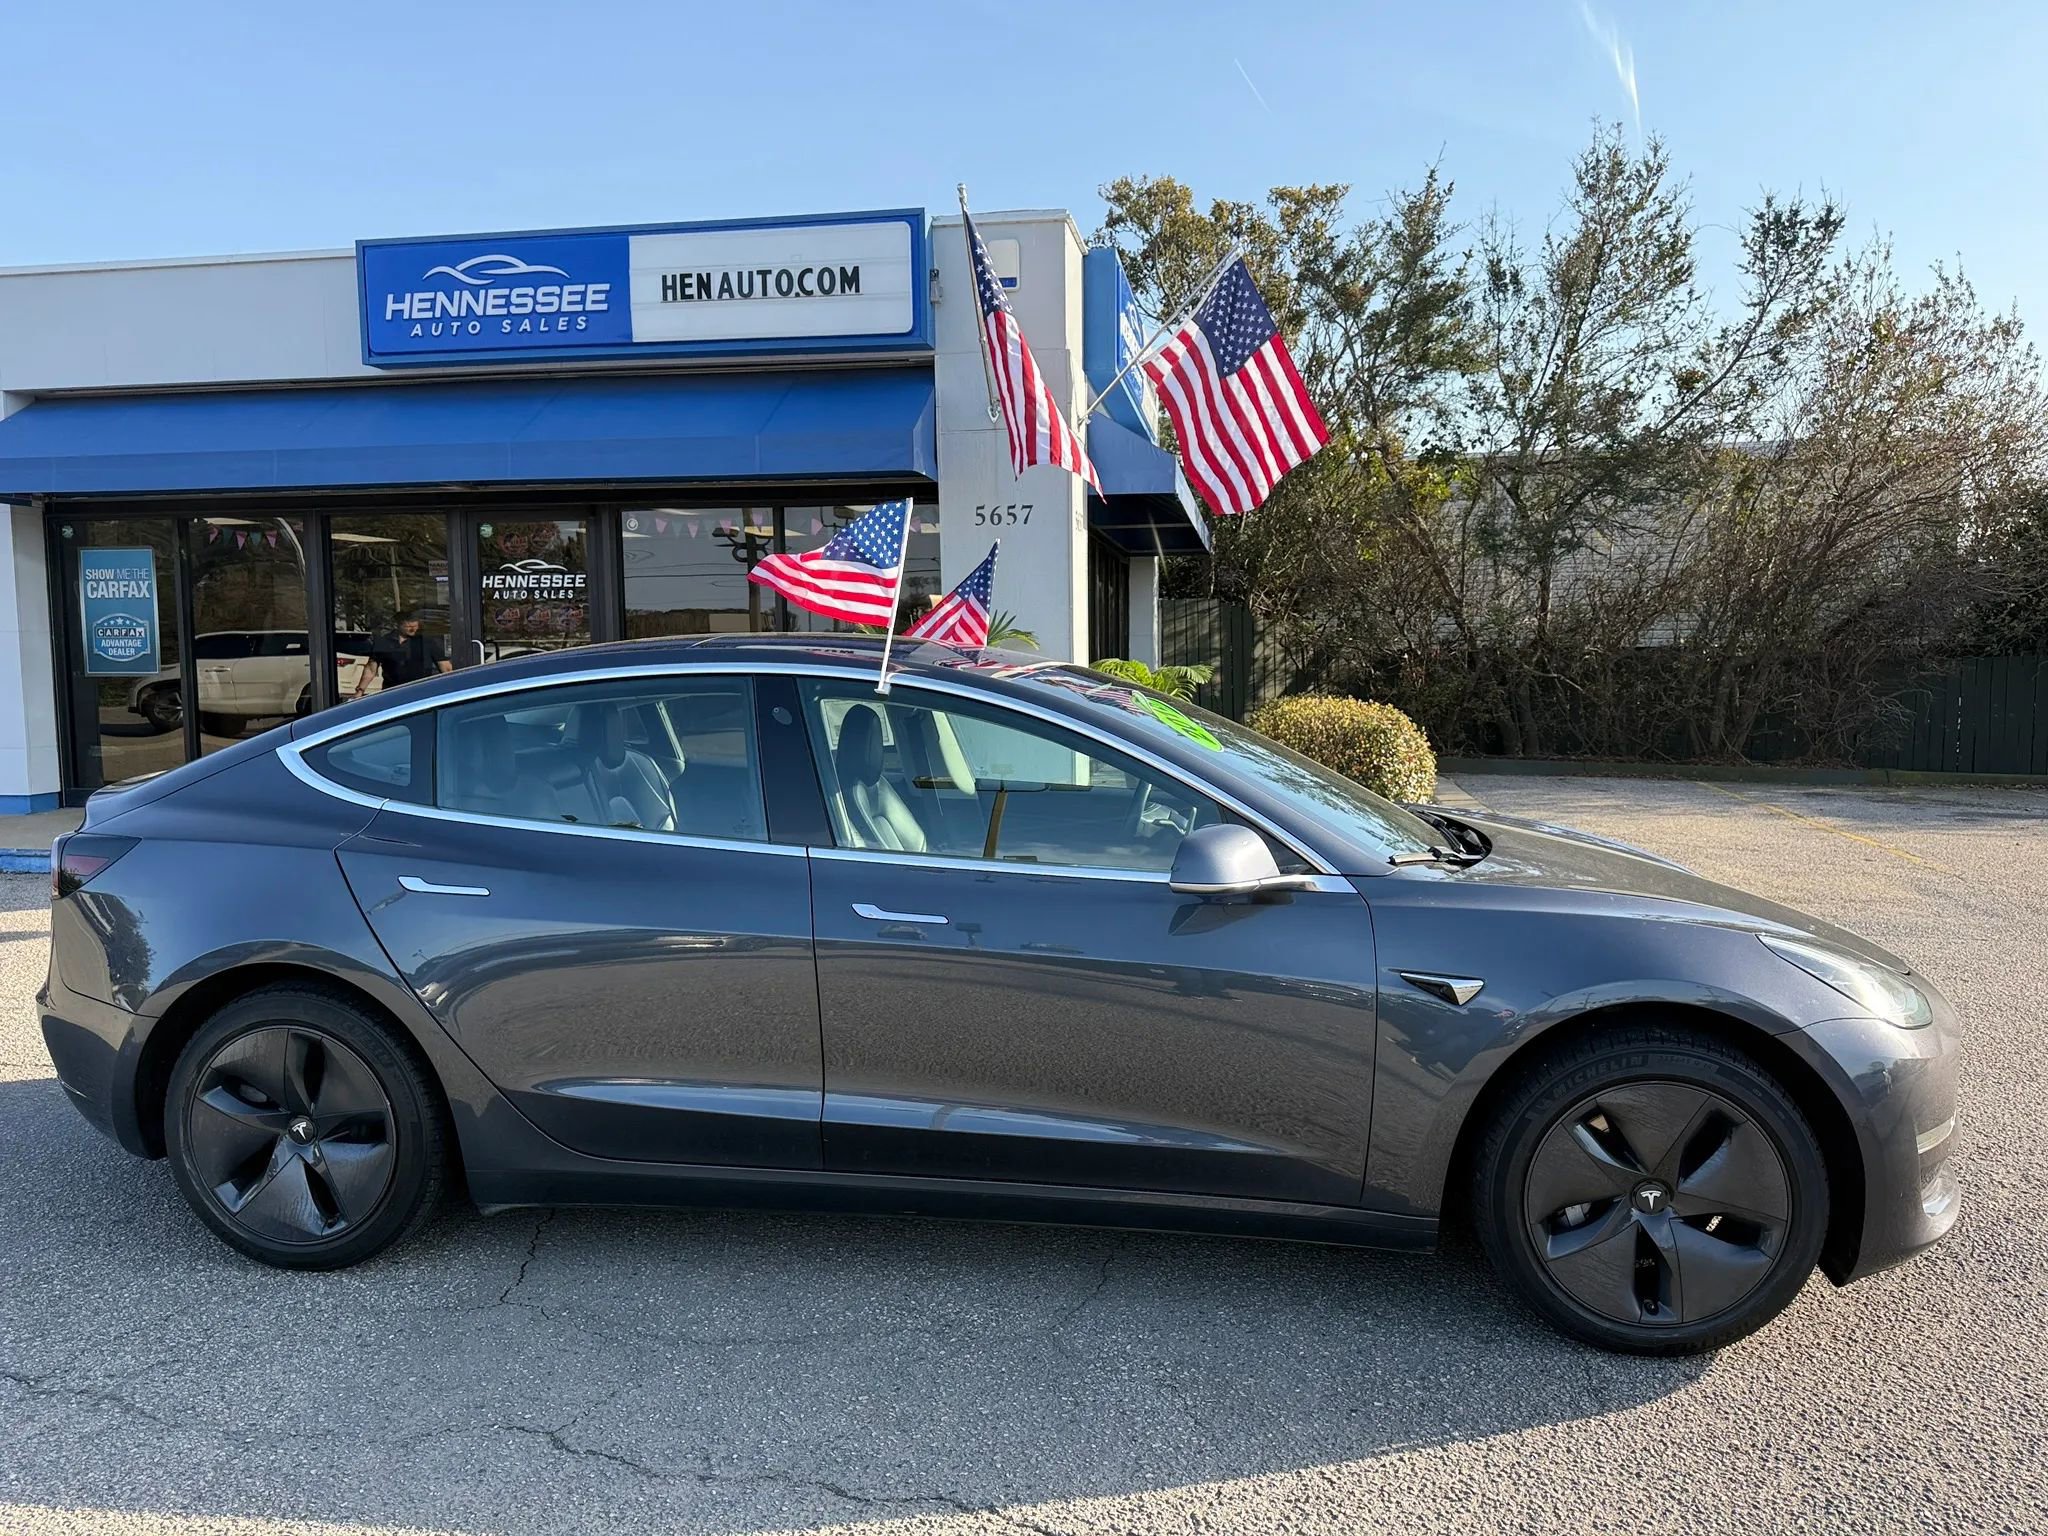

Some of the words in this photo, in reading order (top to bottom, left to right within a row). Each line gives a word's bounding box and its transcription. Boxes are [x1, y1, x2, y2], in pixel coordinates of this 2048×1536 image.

[661, 265, 861, 302] HENAUTO.COM
[385, 283, 611, 321] HENNESSEE
[410, 320, 482, 337] AUTO
[501, 316, 588, 333] SALES
[974, 503, 1034, 526] 5657
[85, 568, 115, 580] SHOW
[116, 568, 131, 580] ME
[132, 568, 149, 580] THE
[482, 574, 586, 588] HENNESSEE
[86, 581, 151, 599] CARFAX
[493, 590, 528, 600] AUTO
[534, 589, 574, 599] SALES
[97, 627, 145, 638] CARFAX
[101, 639, 142, 648] ADVANTAGE
[108, 647, 136, 656] DEALER
